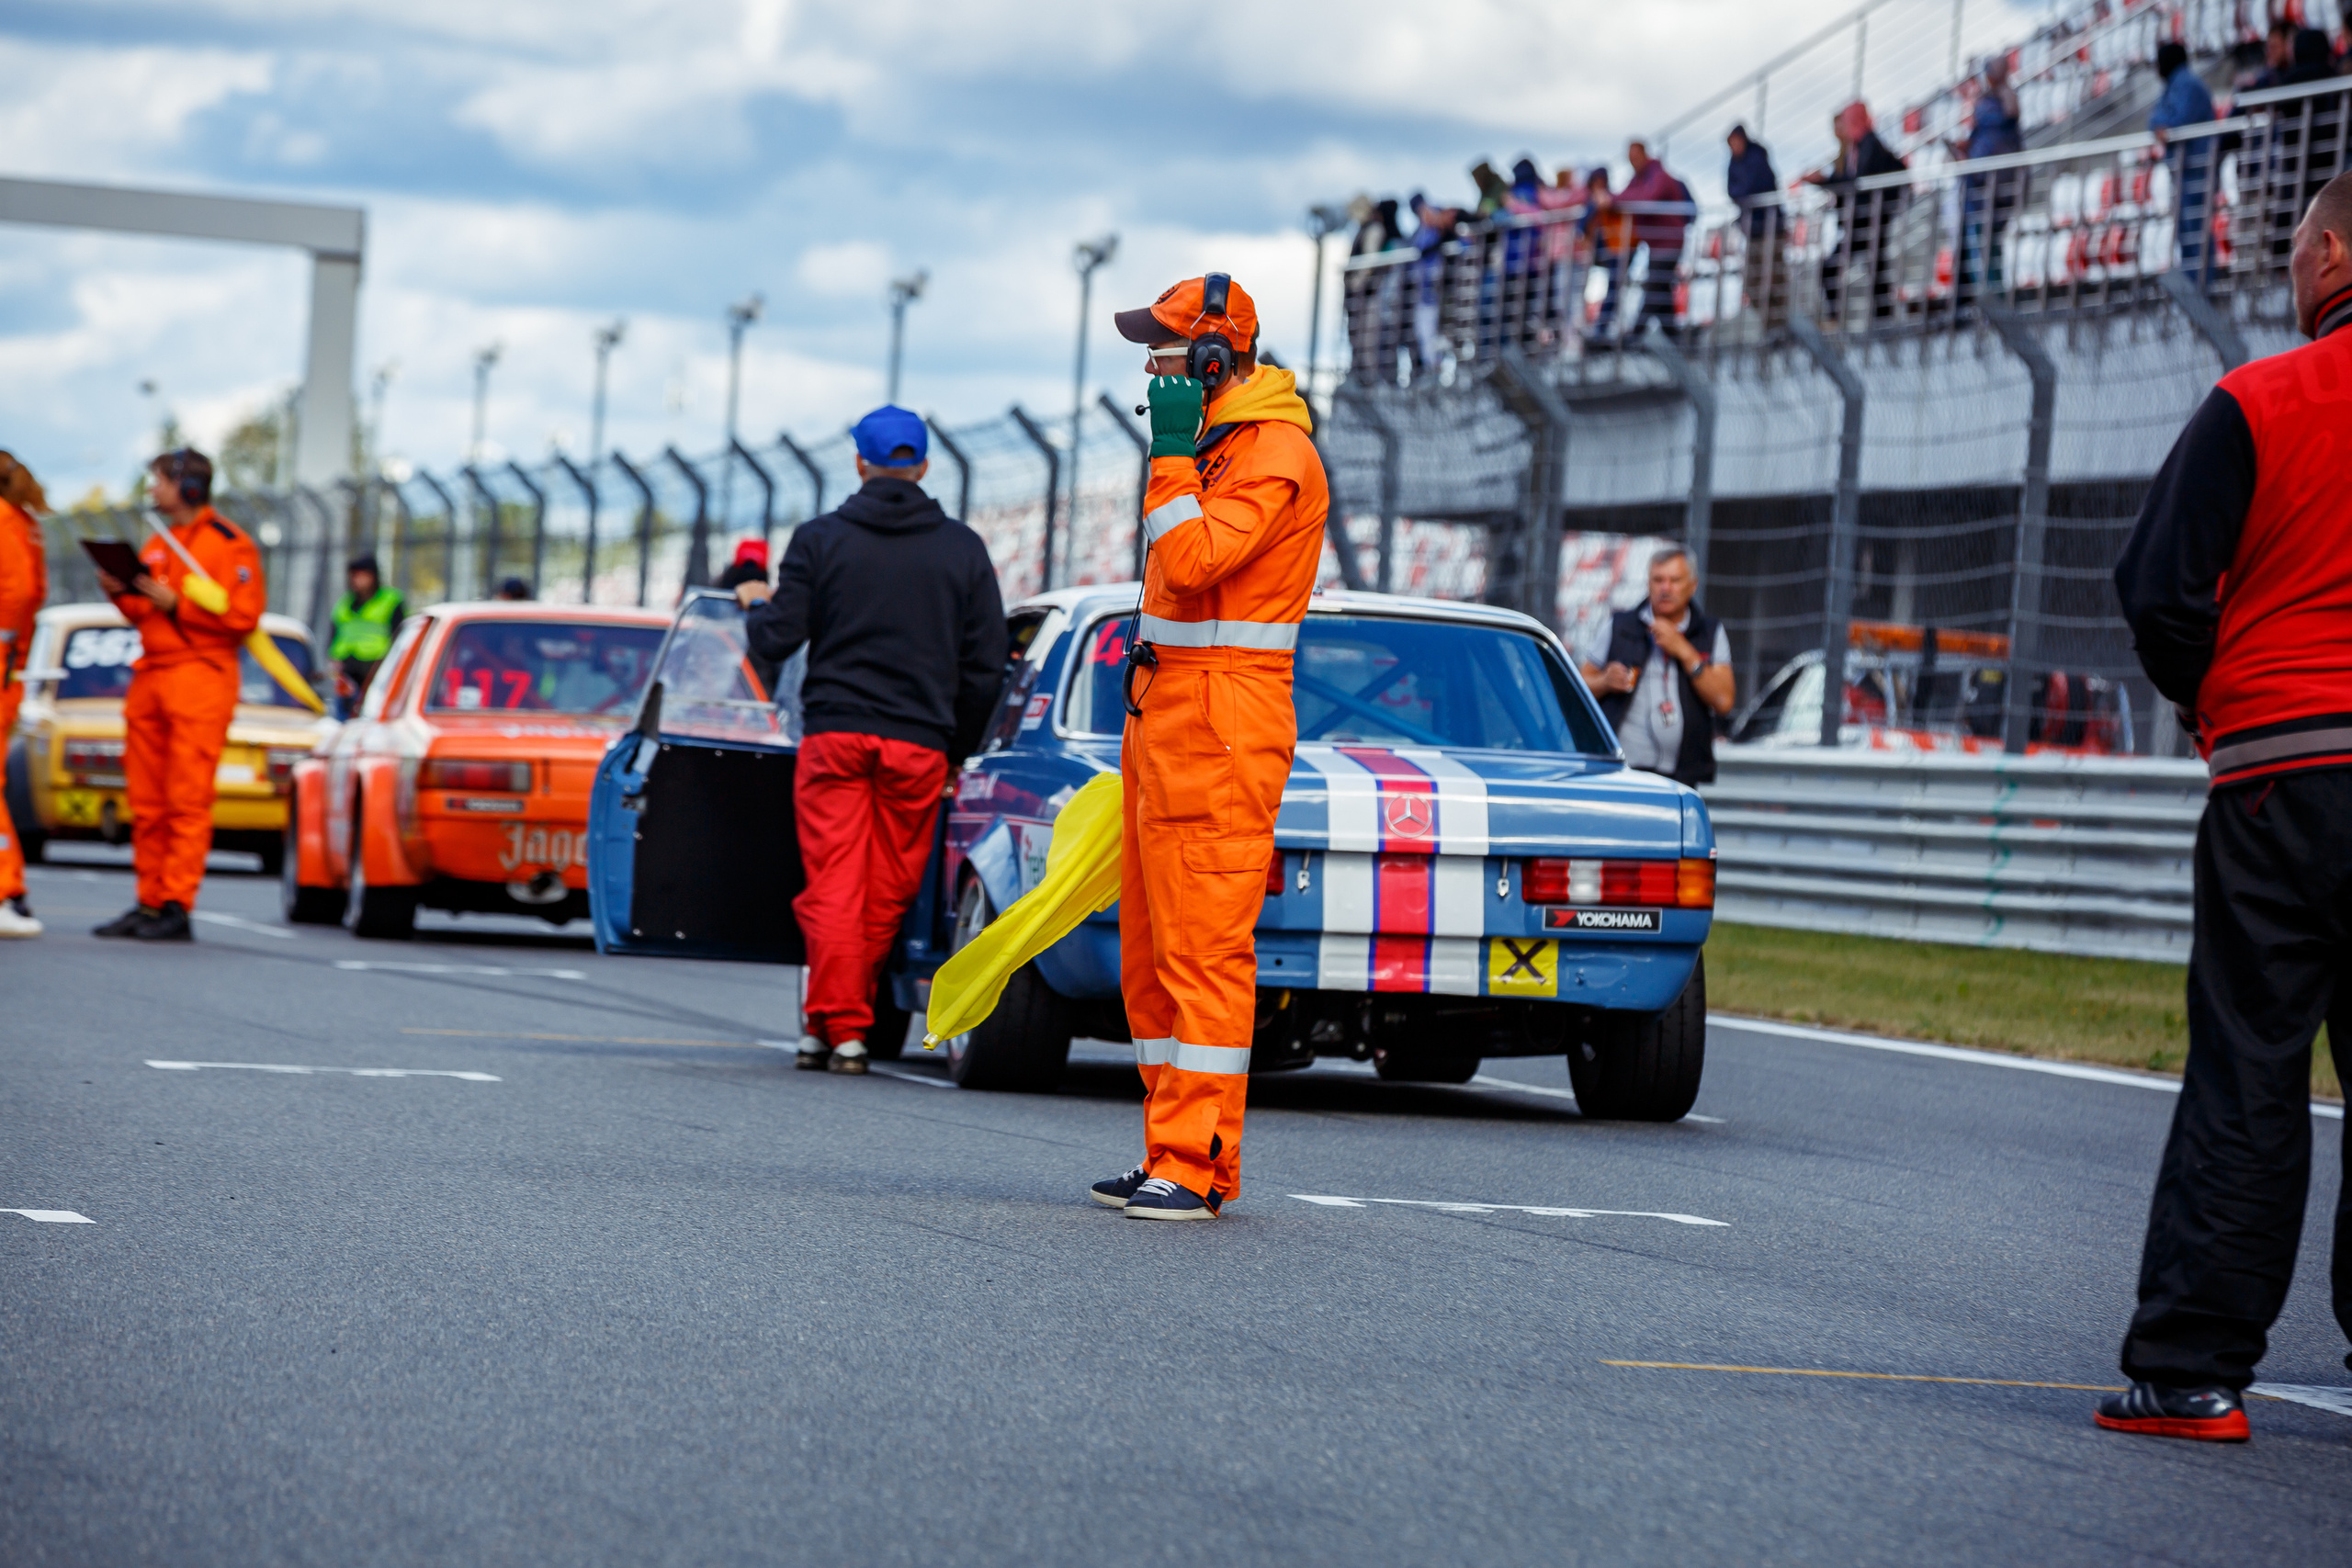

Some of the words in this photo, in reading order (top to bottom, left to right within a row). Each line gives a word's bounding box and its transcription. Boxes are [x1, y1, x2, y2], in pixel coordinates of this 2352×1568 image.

[1085, 621, 1140, 666] 4
[442, 668, 532, 710] 117
[1576, 911, 1653, 928] YOKOHAMA
